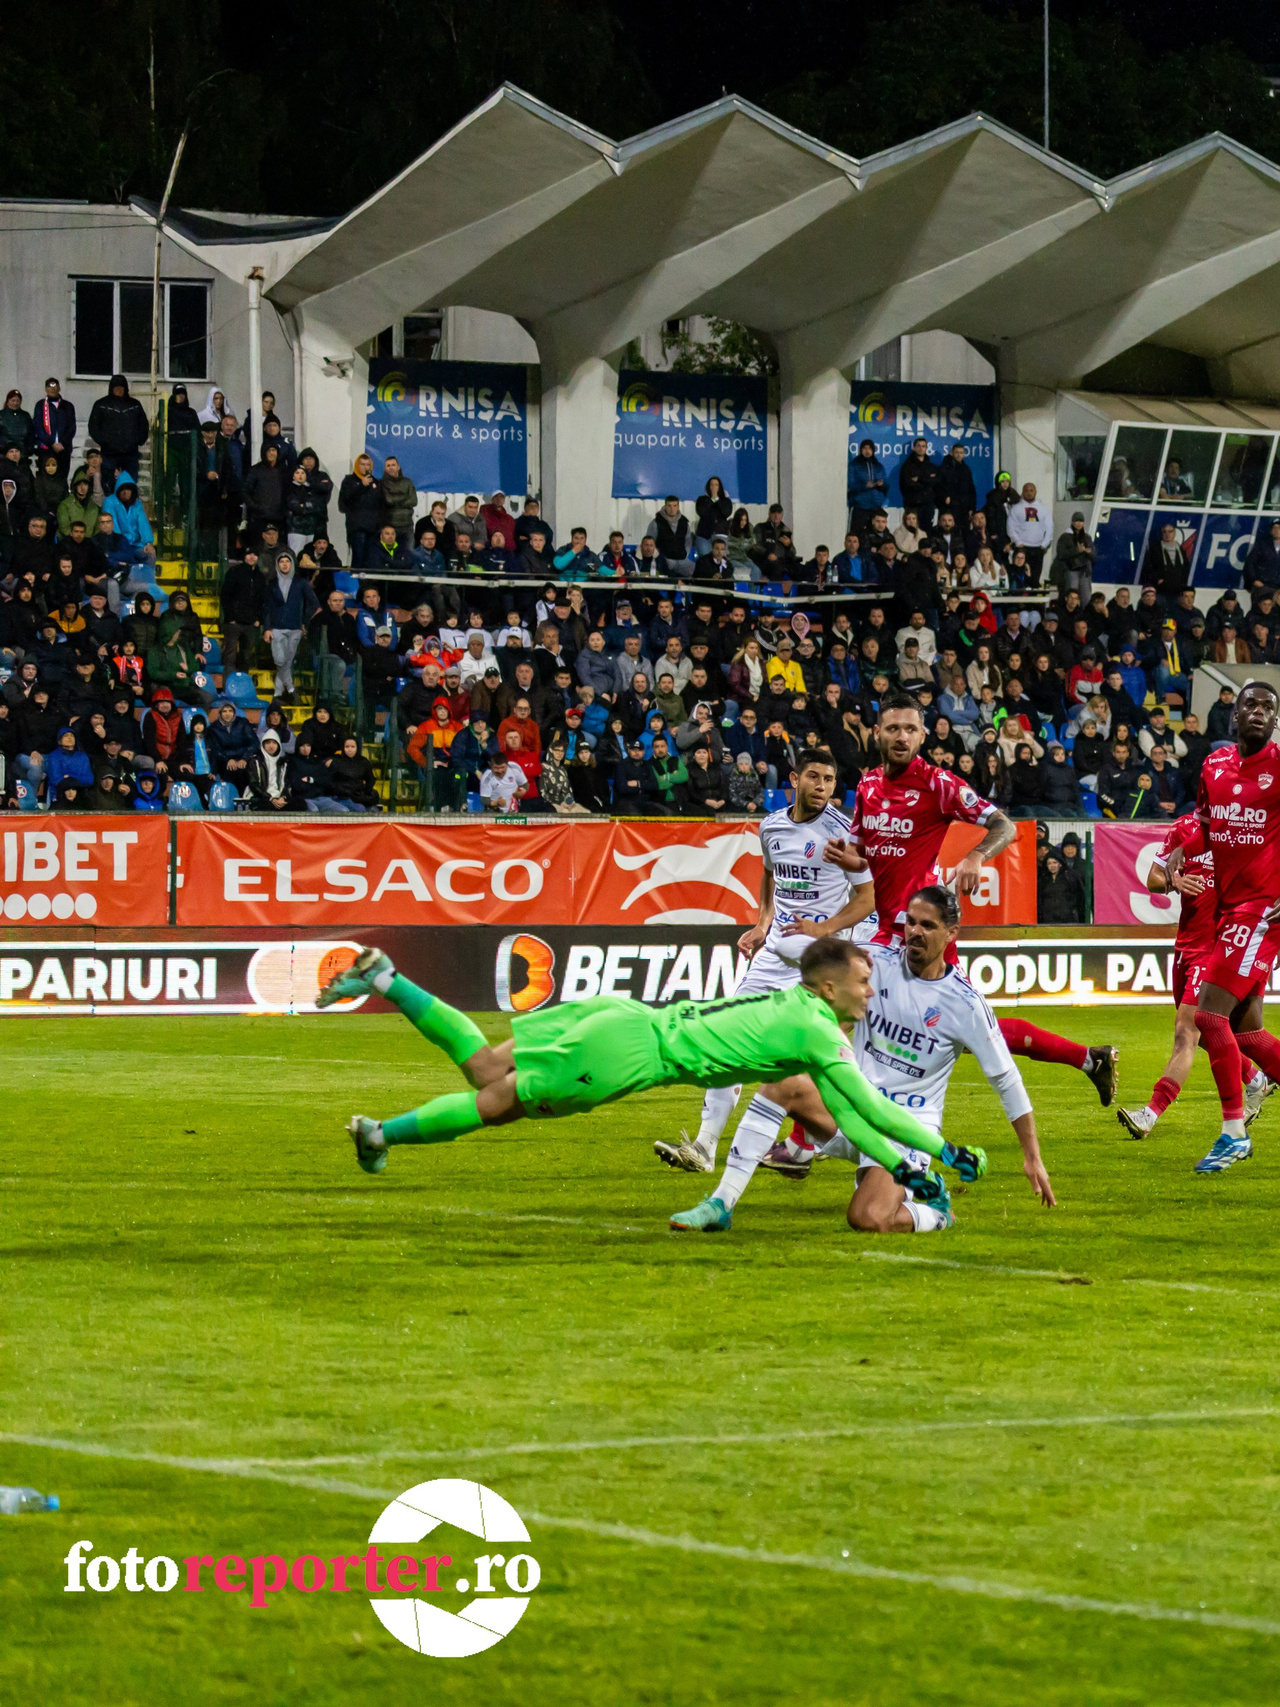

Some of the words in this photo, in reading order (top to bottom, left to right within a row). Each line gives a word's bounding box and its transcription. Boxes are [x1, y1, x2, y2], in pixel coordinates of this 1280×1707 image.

[452, 424, 463, 439] &
[470, 426, 524, 444] sports
[694, 433, 706, 449] &
[712, 436, 764, 453] sports
[943, 443, 991, 459] sorts
[1209, 802, 1268, 824] WIN2.RO
[4, 830, 139, 882] IBET
[1220, 923, 1252, 948] 28
[0, 956, 218, 1001] PARIURI
[960, 953, 1095, 996] ODUL
[867, 1009, 940, 1056] UNIBET
